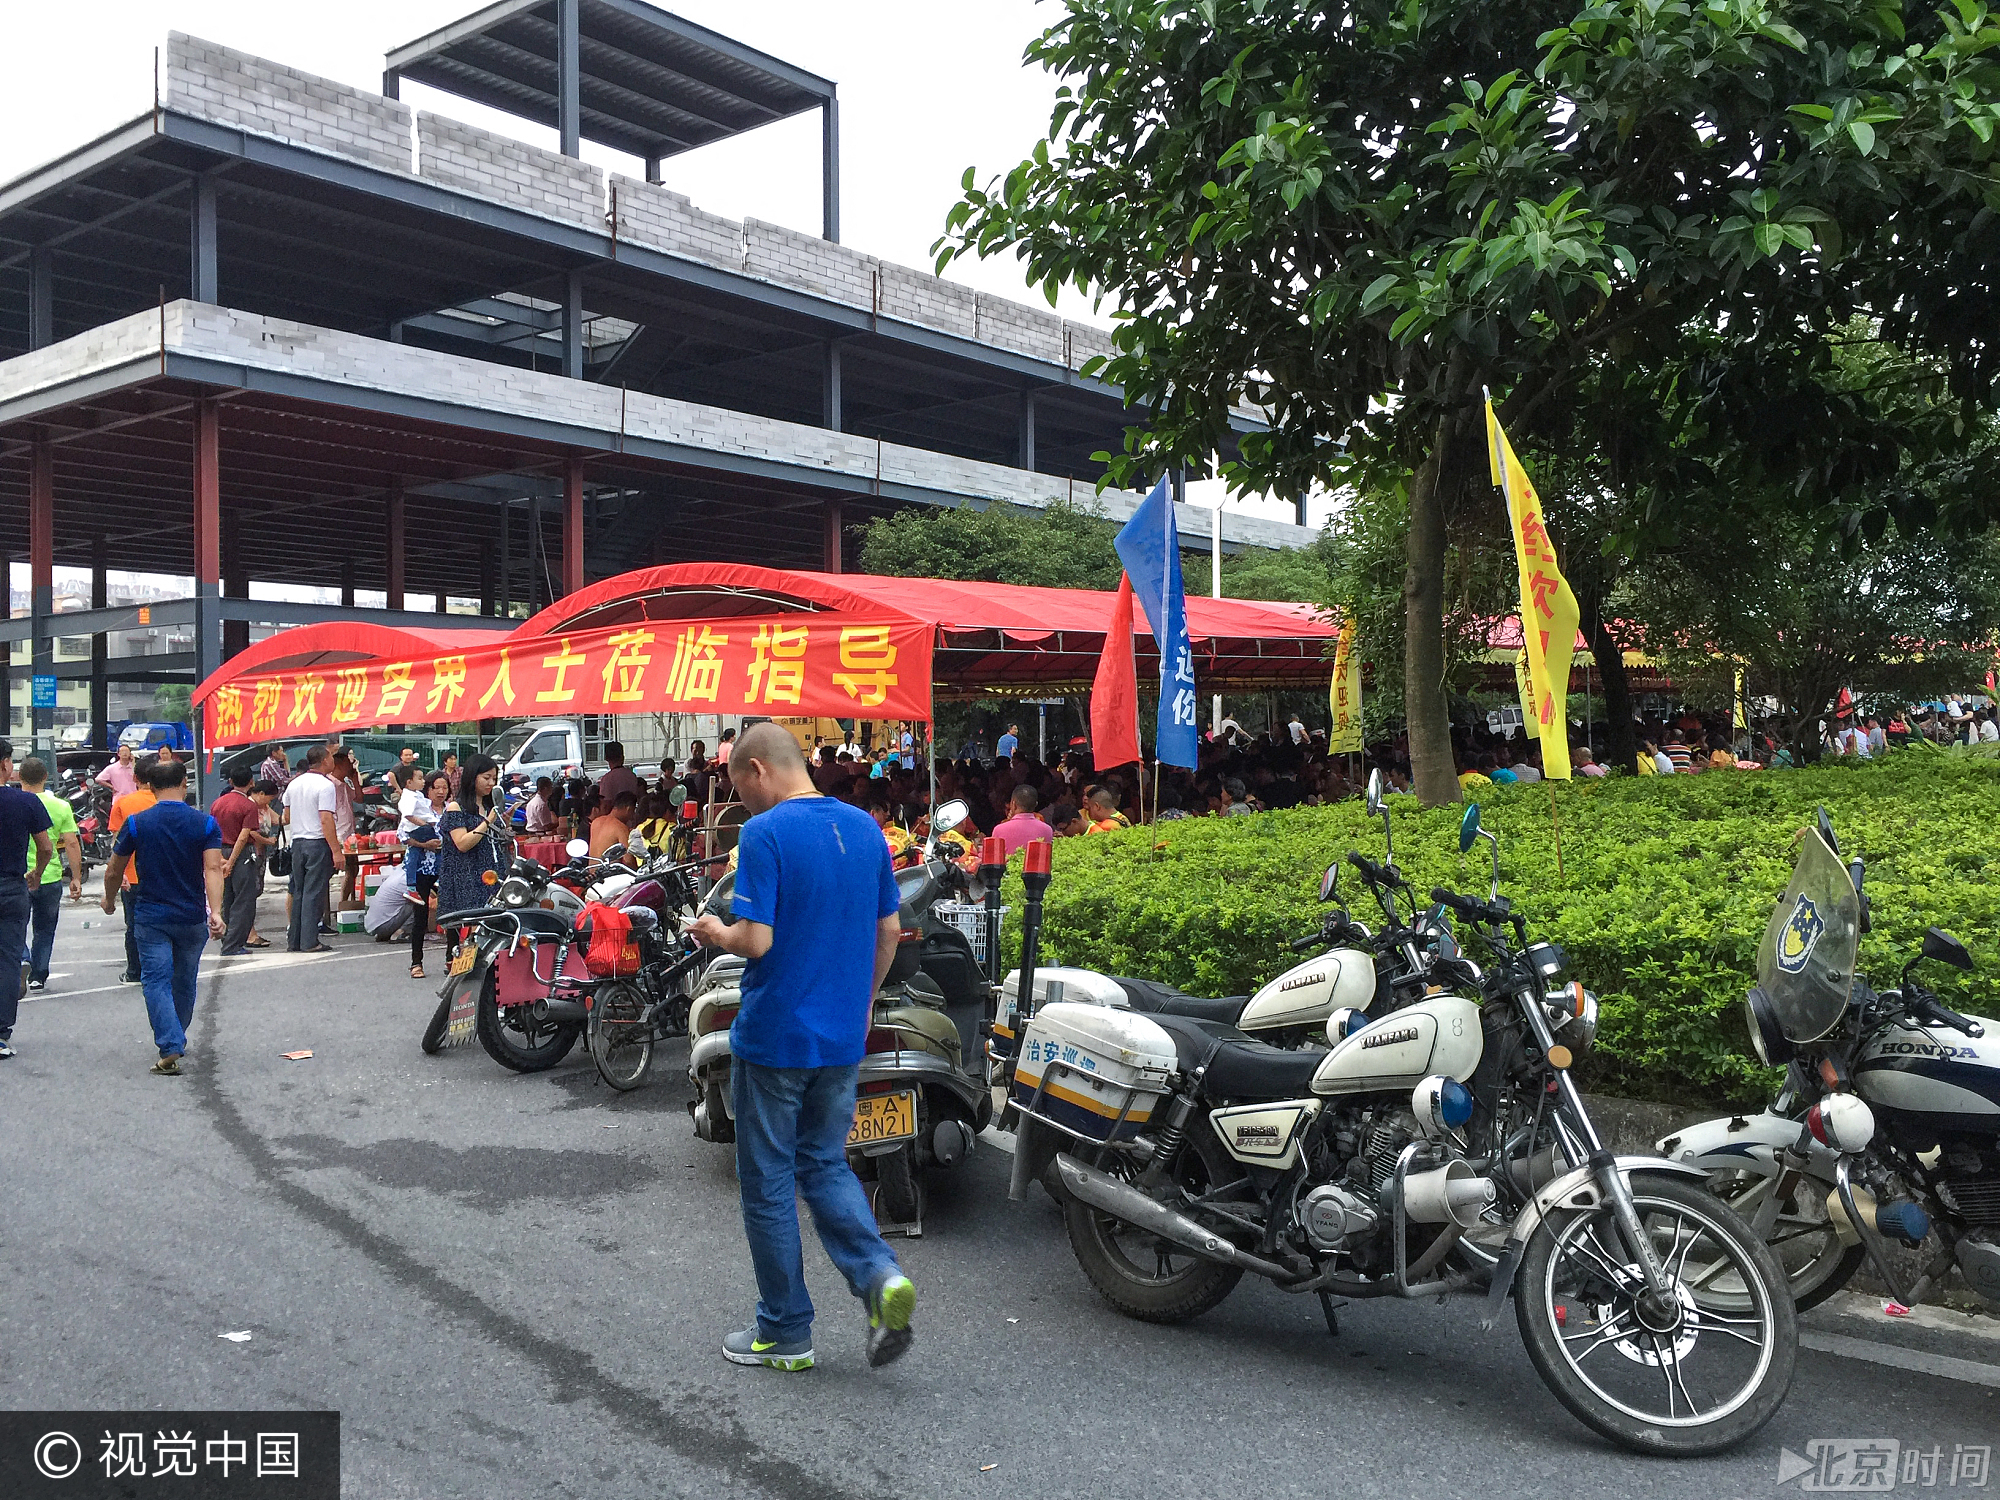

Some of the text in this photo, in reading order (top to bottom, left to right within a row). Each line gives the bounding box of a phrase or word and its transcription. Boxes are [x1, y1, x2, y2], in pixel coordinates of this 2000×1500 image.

[214, 624, 899, 740] 热烈欢迎各界人士莅临指导
[1278, 973, 1326, 992] YUANFANG
[453, 1001, 475, 1012] HONDA
[1360, 1027, 1418, 1049] YUANFANG
[1880, 1043, 1979, 1058] HONDA
